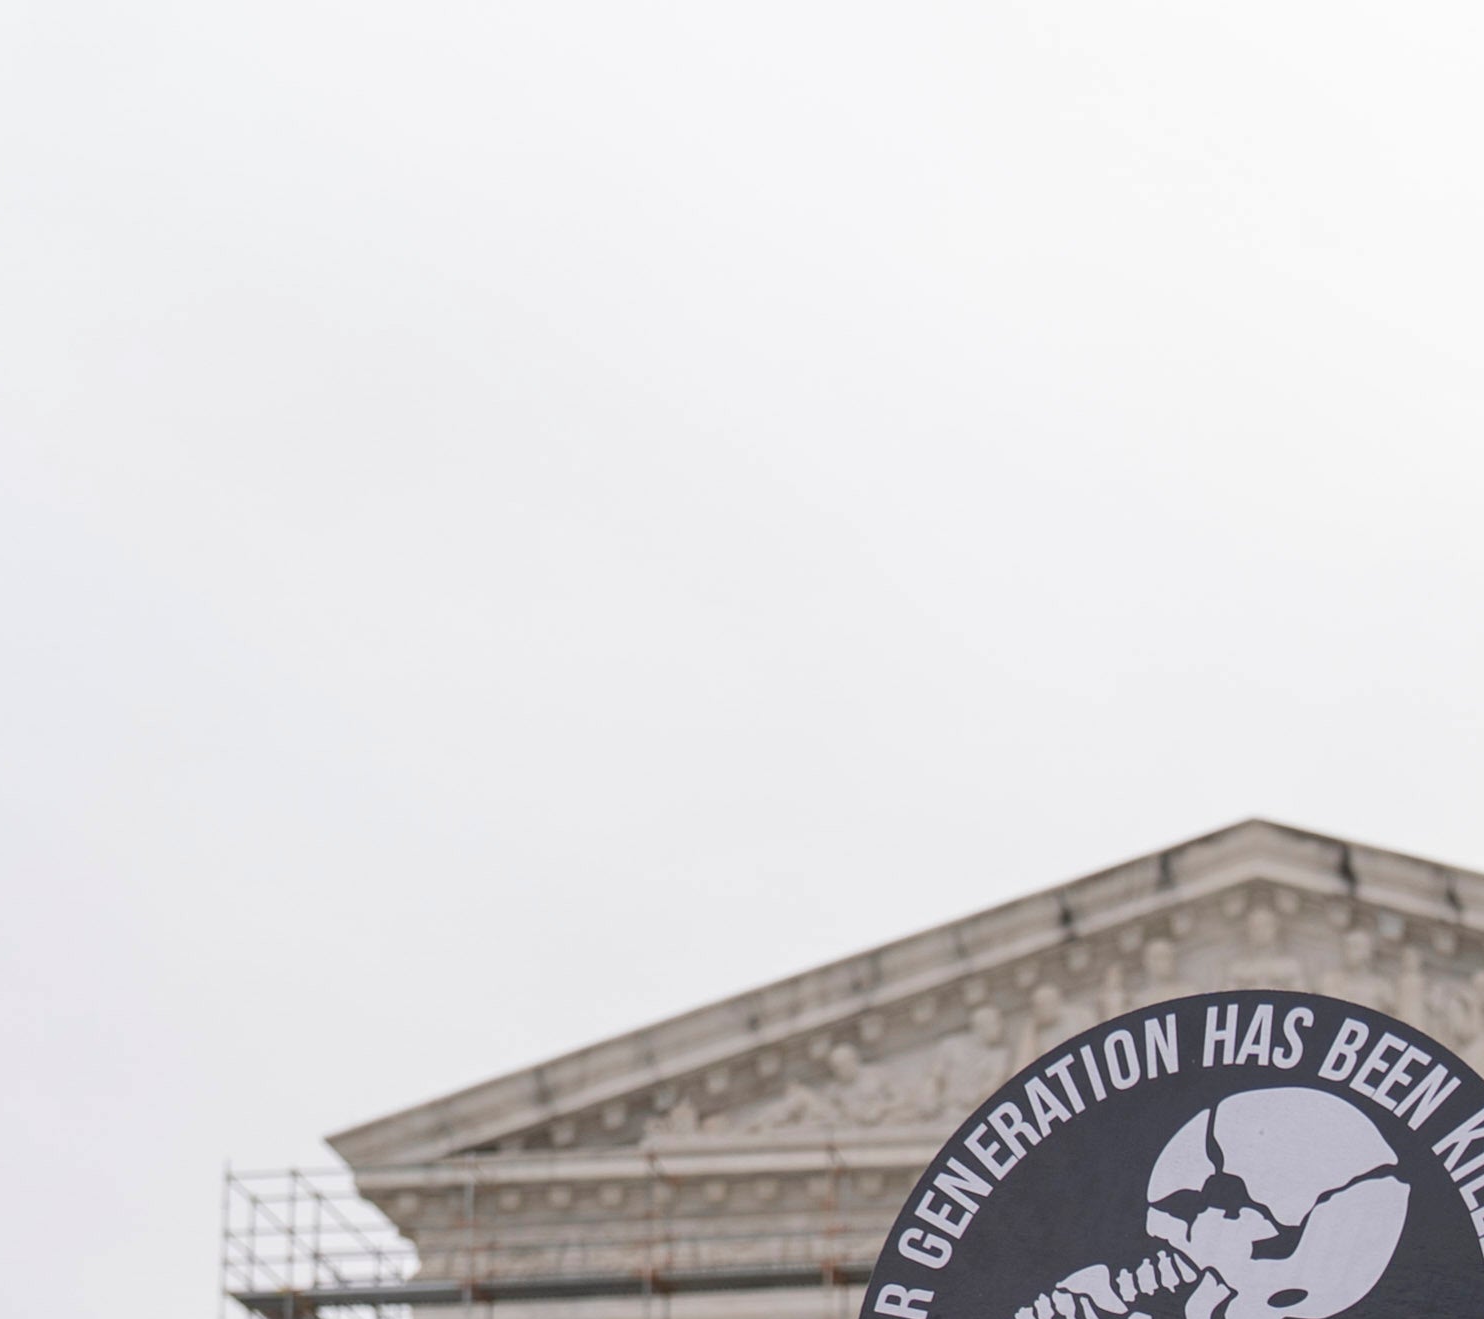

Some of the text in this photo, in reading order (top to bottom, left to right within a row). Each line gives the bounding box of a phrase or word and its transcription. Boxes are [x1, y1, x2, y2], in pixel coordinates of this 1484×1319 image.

[897, 1012, 1179, 1270] GENERATION
[1202, 1004, 1315, 1069] HAS
[1318, 1017, 1461, 1132] BEEN
